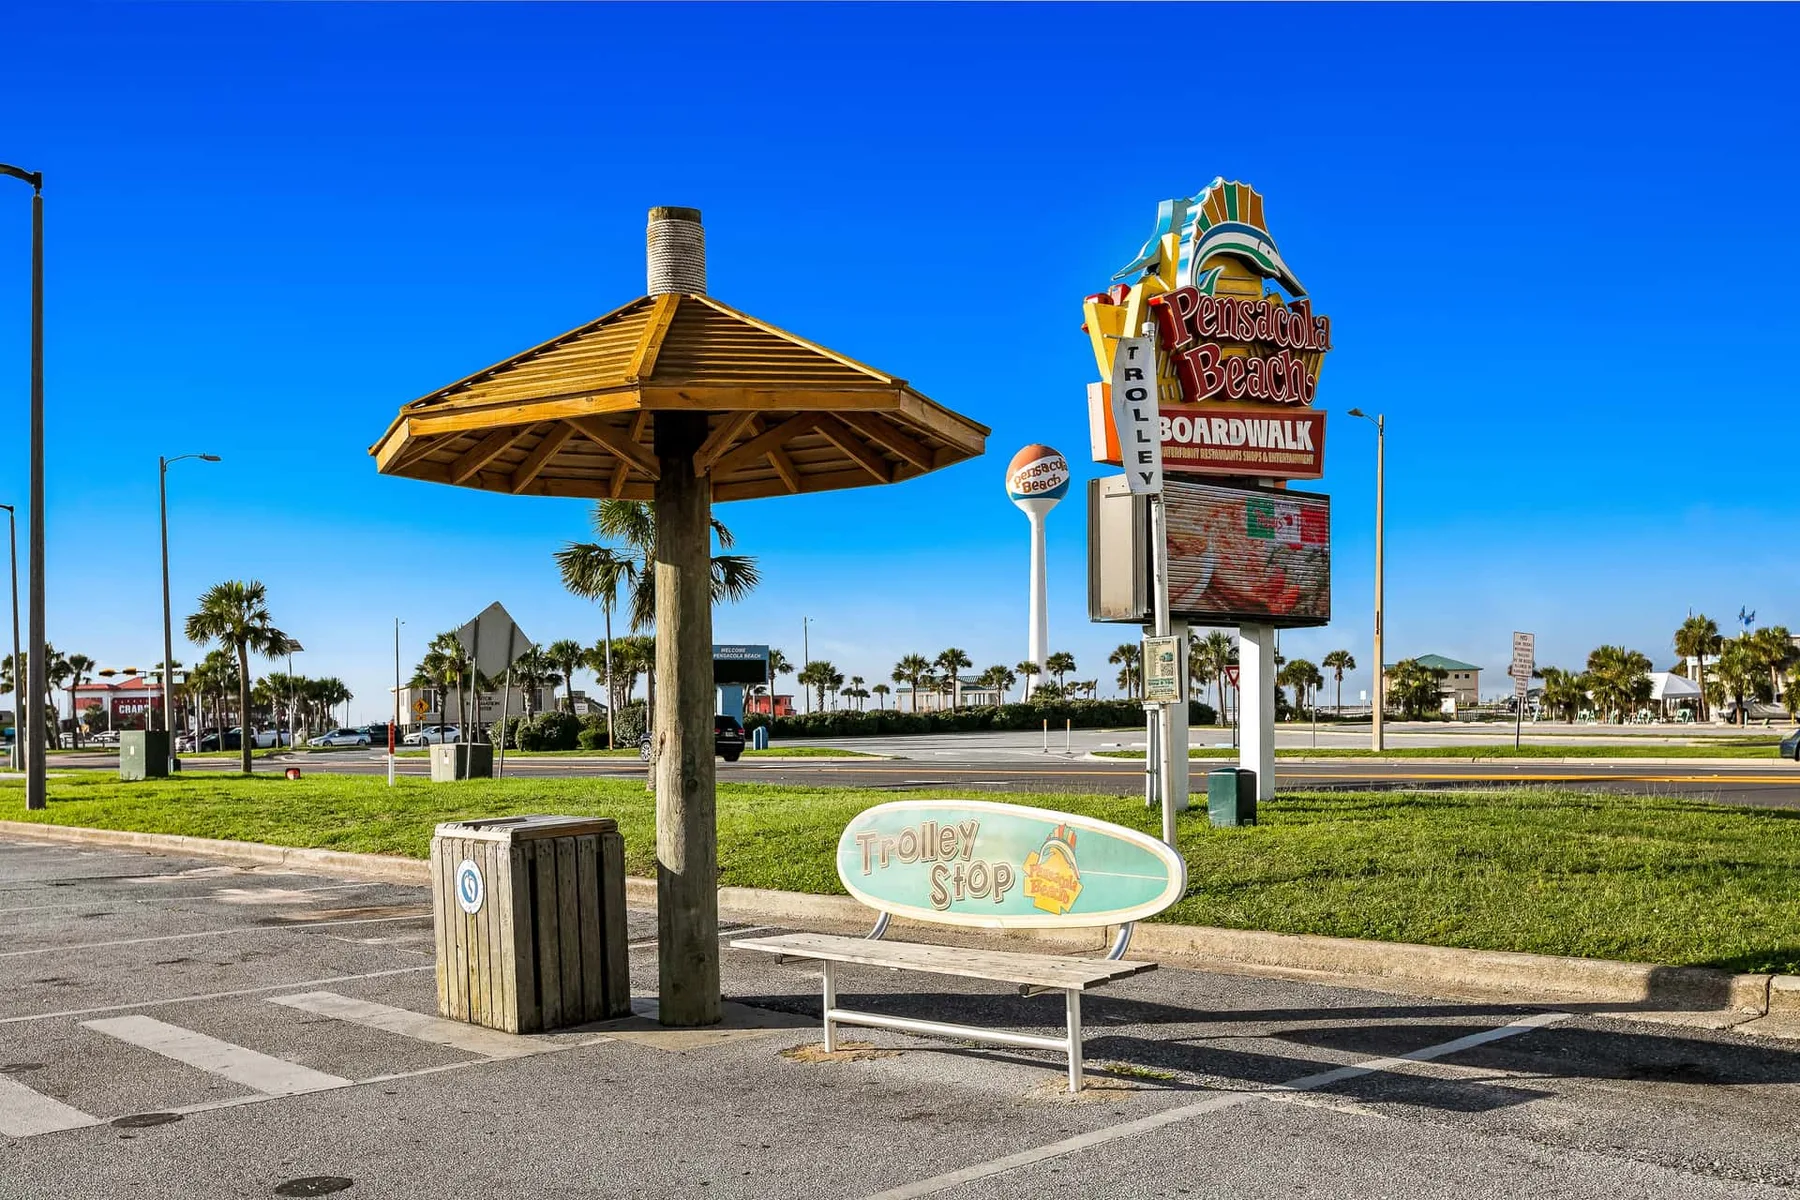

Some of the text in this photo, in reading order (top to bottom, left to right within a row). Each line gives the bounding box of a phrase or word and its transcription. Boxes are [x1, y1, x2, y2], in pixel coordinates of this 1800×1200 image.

[1163, 285, 1333, 352] Pensacola
[1184, 342, 1318, 406] Beach
[1124, 346, 1154, 486] TROLLEY
[1160, 416, 1314, 451] BOARDWALK
[1022, 473, 1061, 493] Beach
[855, 818, 980, 876] Trolley
[929, 860, 1015, 911] Stop
